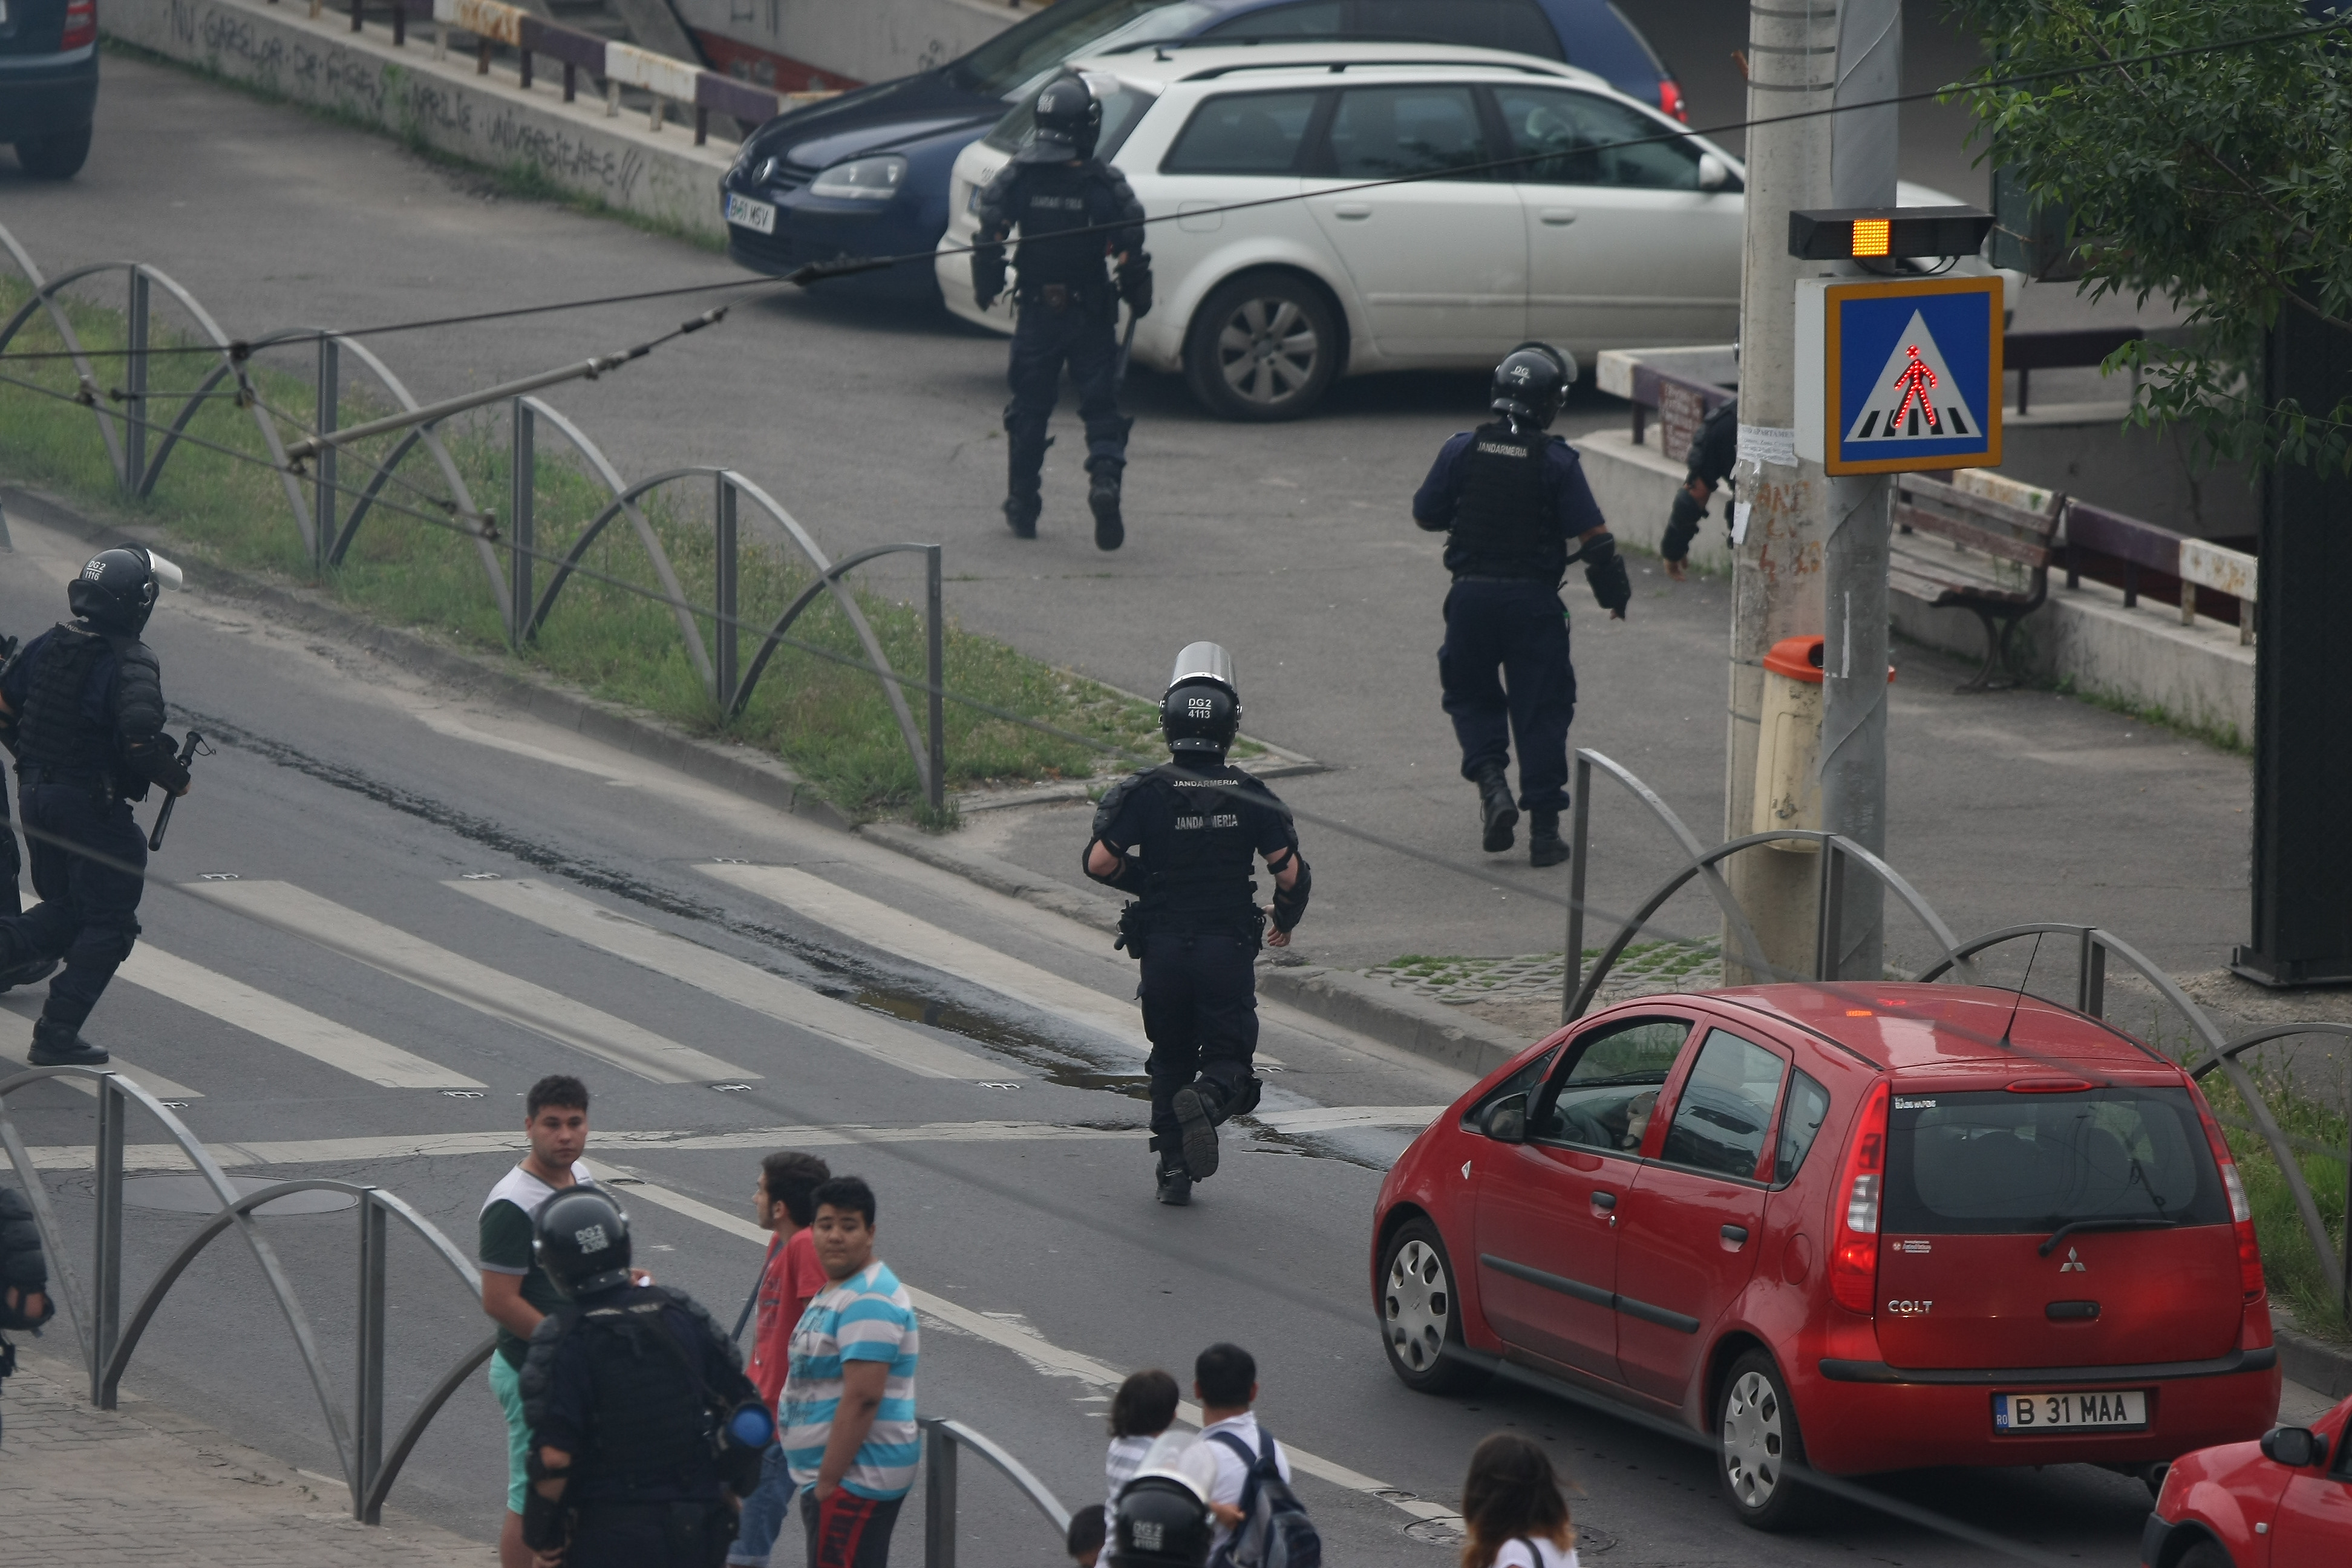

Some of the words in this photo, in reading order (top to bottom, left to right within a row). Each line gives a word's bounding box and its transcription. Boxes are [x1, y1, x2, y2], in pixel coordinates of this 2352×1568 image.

[1477, 442, 1529, 457] JANDARMERIA
[88, 560, 106, 571] DG2
[1188, 697, 1212, 707] DG2
[1187, 709, 1210, 719] 4113
[1174, 779, 1238, 788] JANDARMERIA
[1175, 814, 1238, 829] JANDAMERIA
[1888, 1300, 1933, 1314] COLT
[1996, 1414, 2008, 1425] RO
[2016, 1398, 2035, 1425] B
[2046, 1396, 2070, 1423] 31
[2080, 1394, 2128, 1422] MAA
